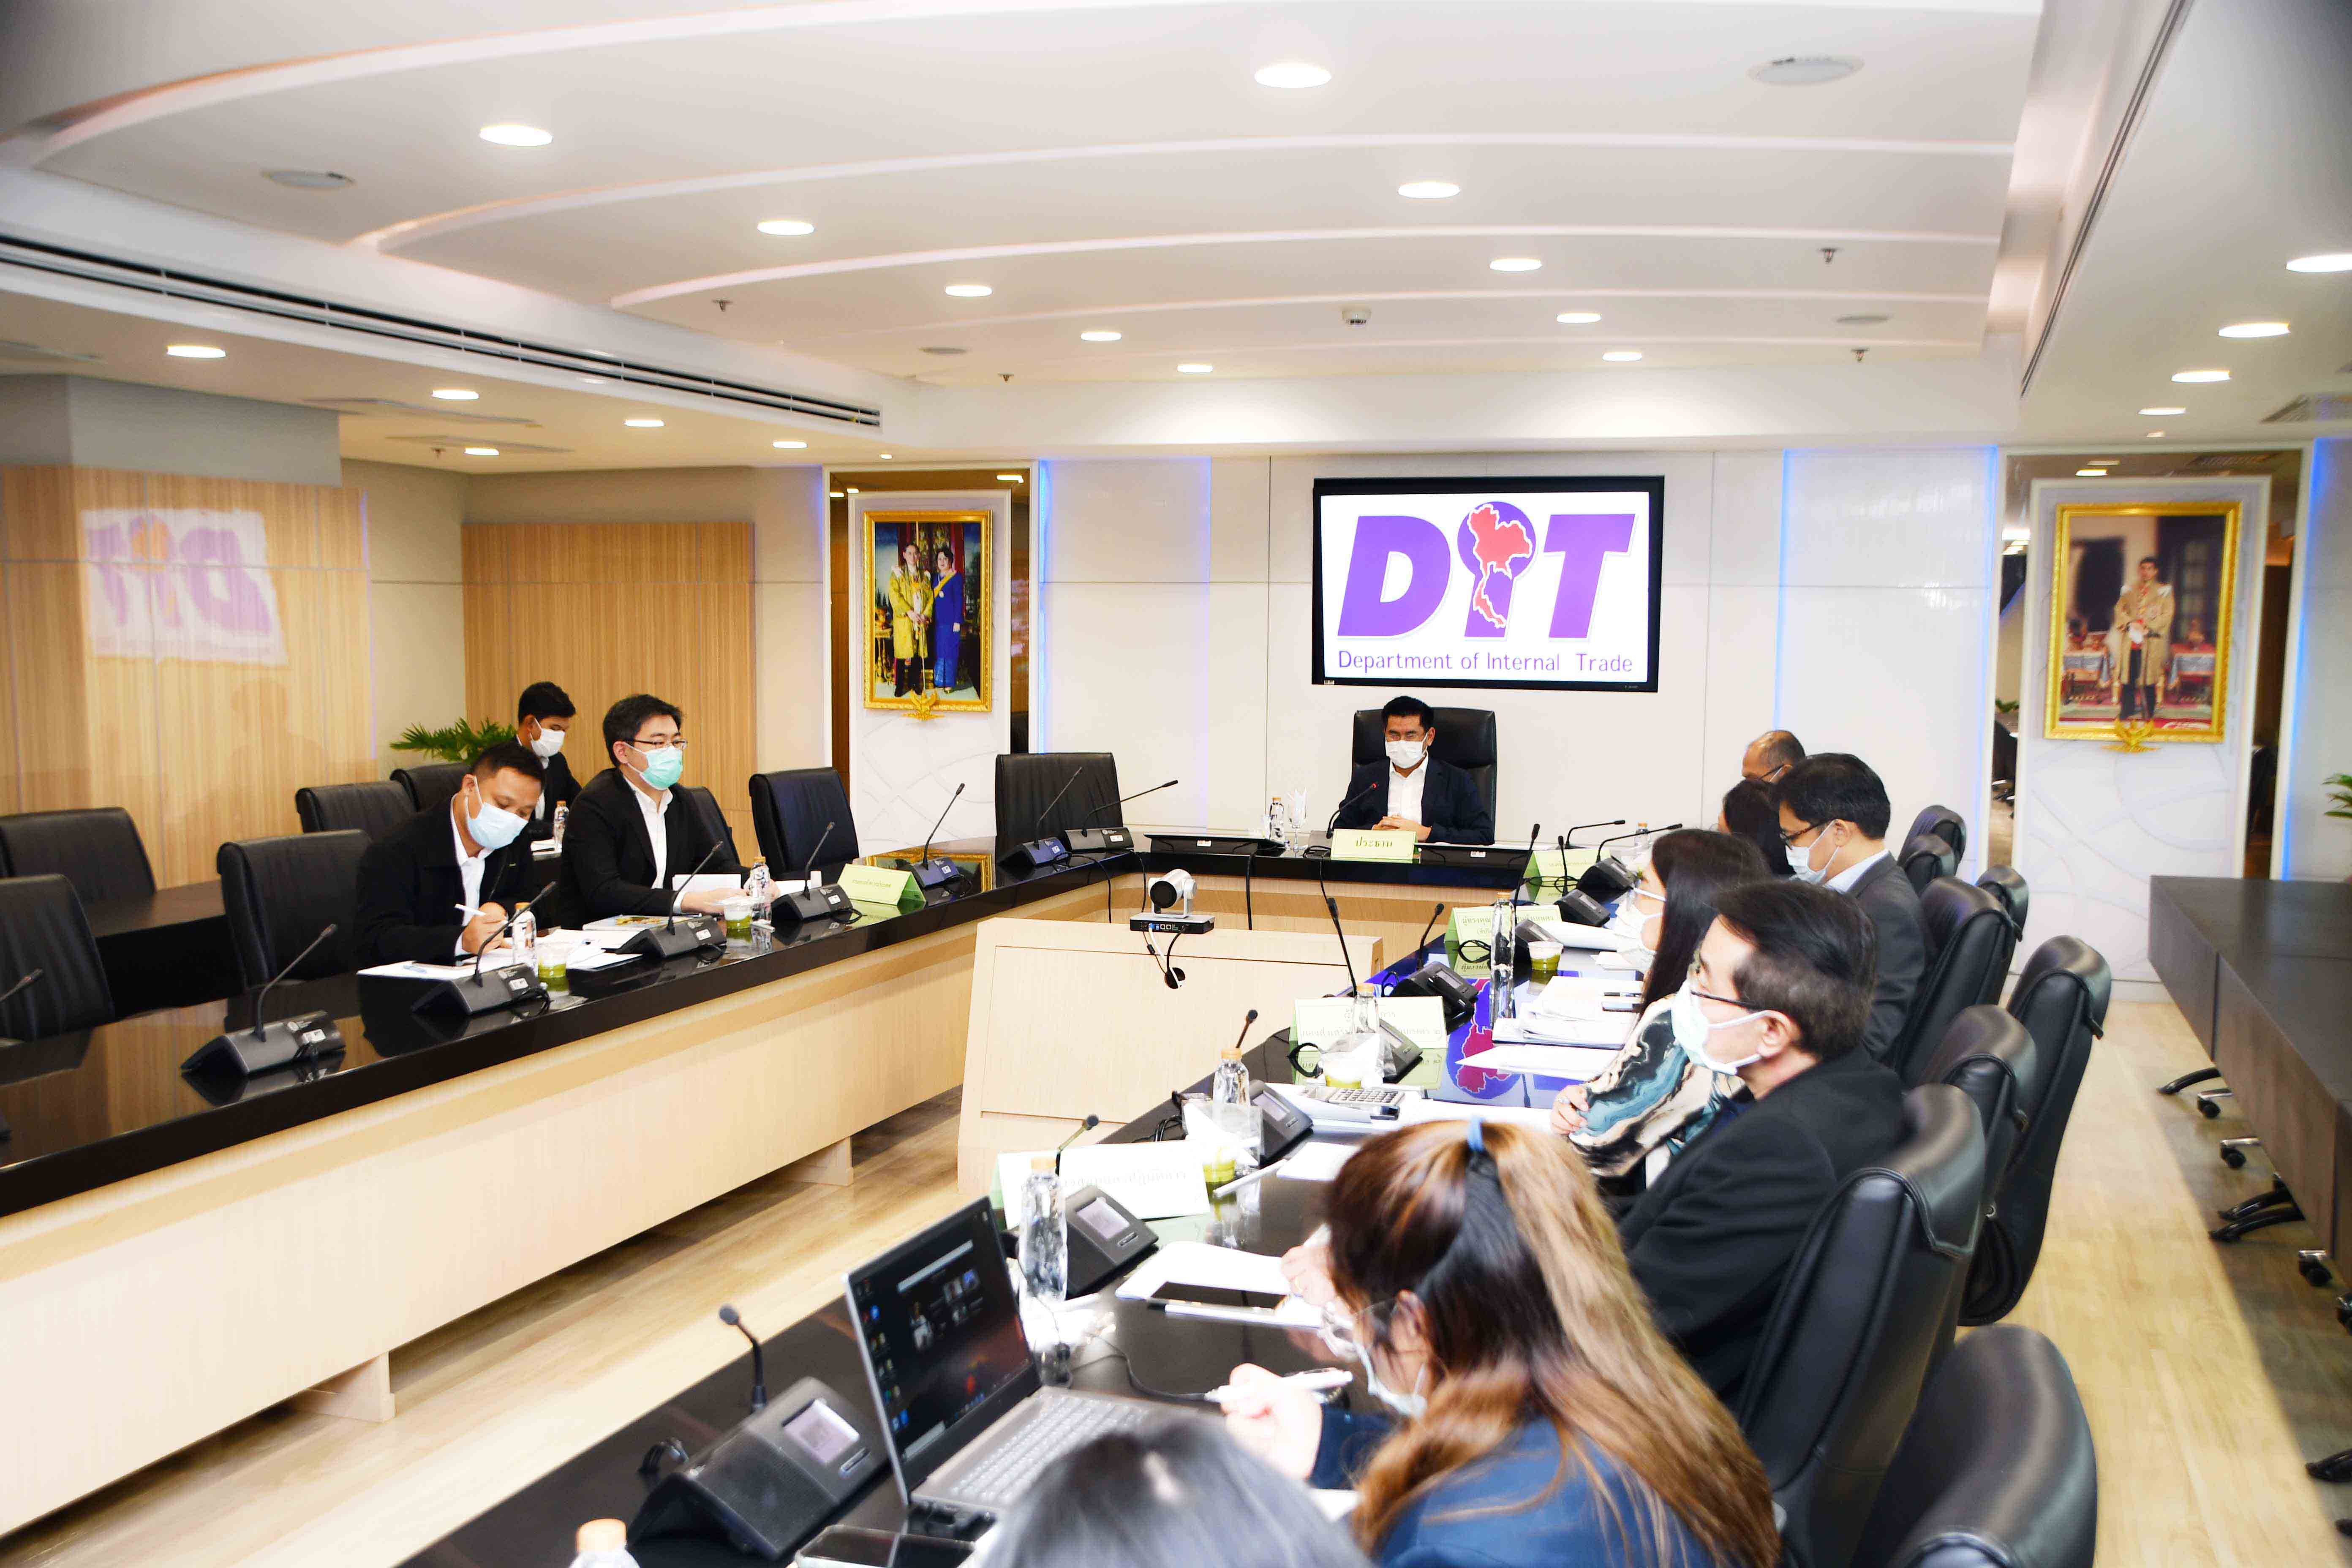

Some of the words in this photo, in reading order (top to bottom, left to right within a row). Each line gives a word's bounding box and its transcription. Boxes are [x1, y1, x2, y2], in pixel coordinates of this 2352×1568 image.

[1338, 650, 1452, 673] Department
[1461, 652, 1479, 669] of
[1487, 652, 1560, 671] Internal
[1576, 653, 1633, 672] Trade
